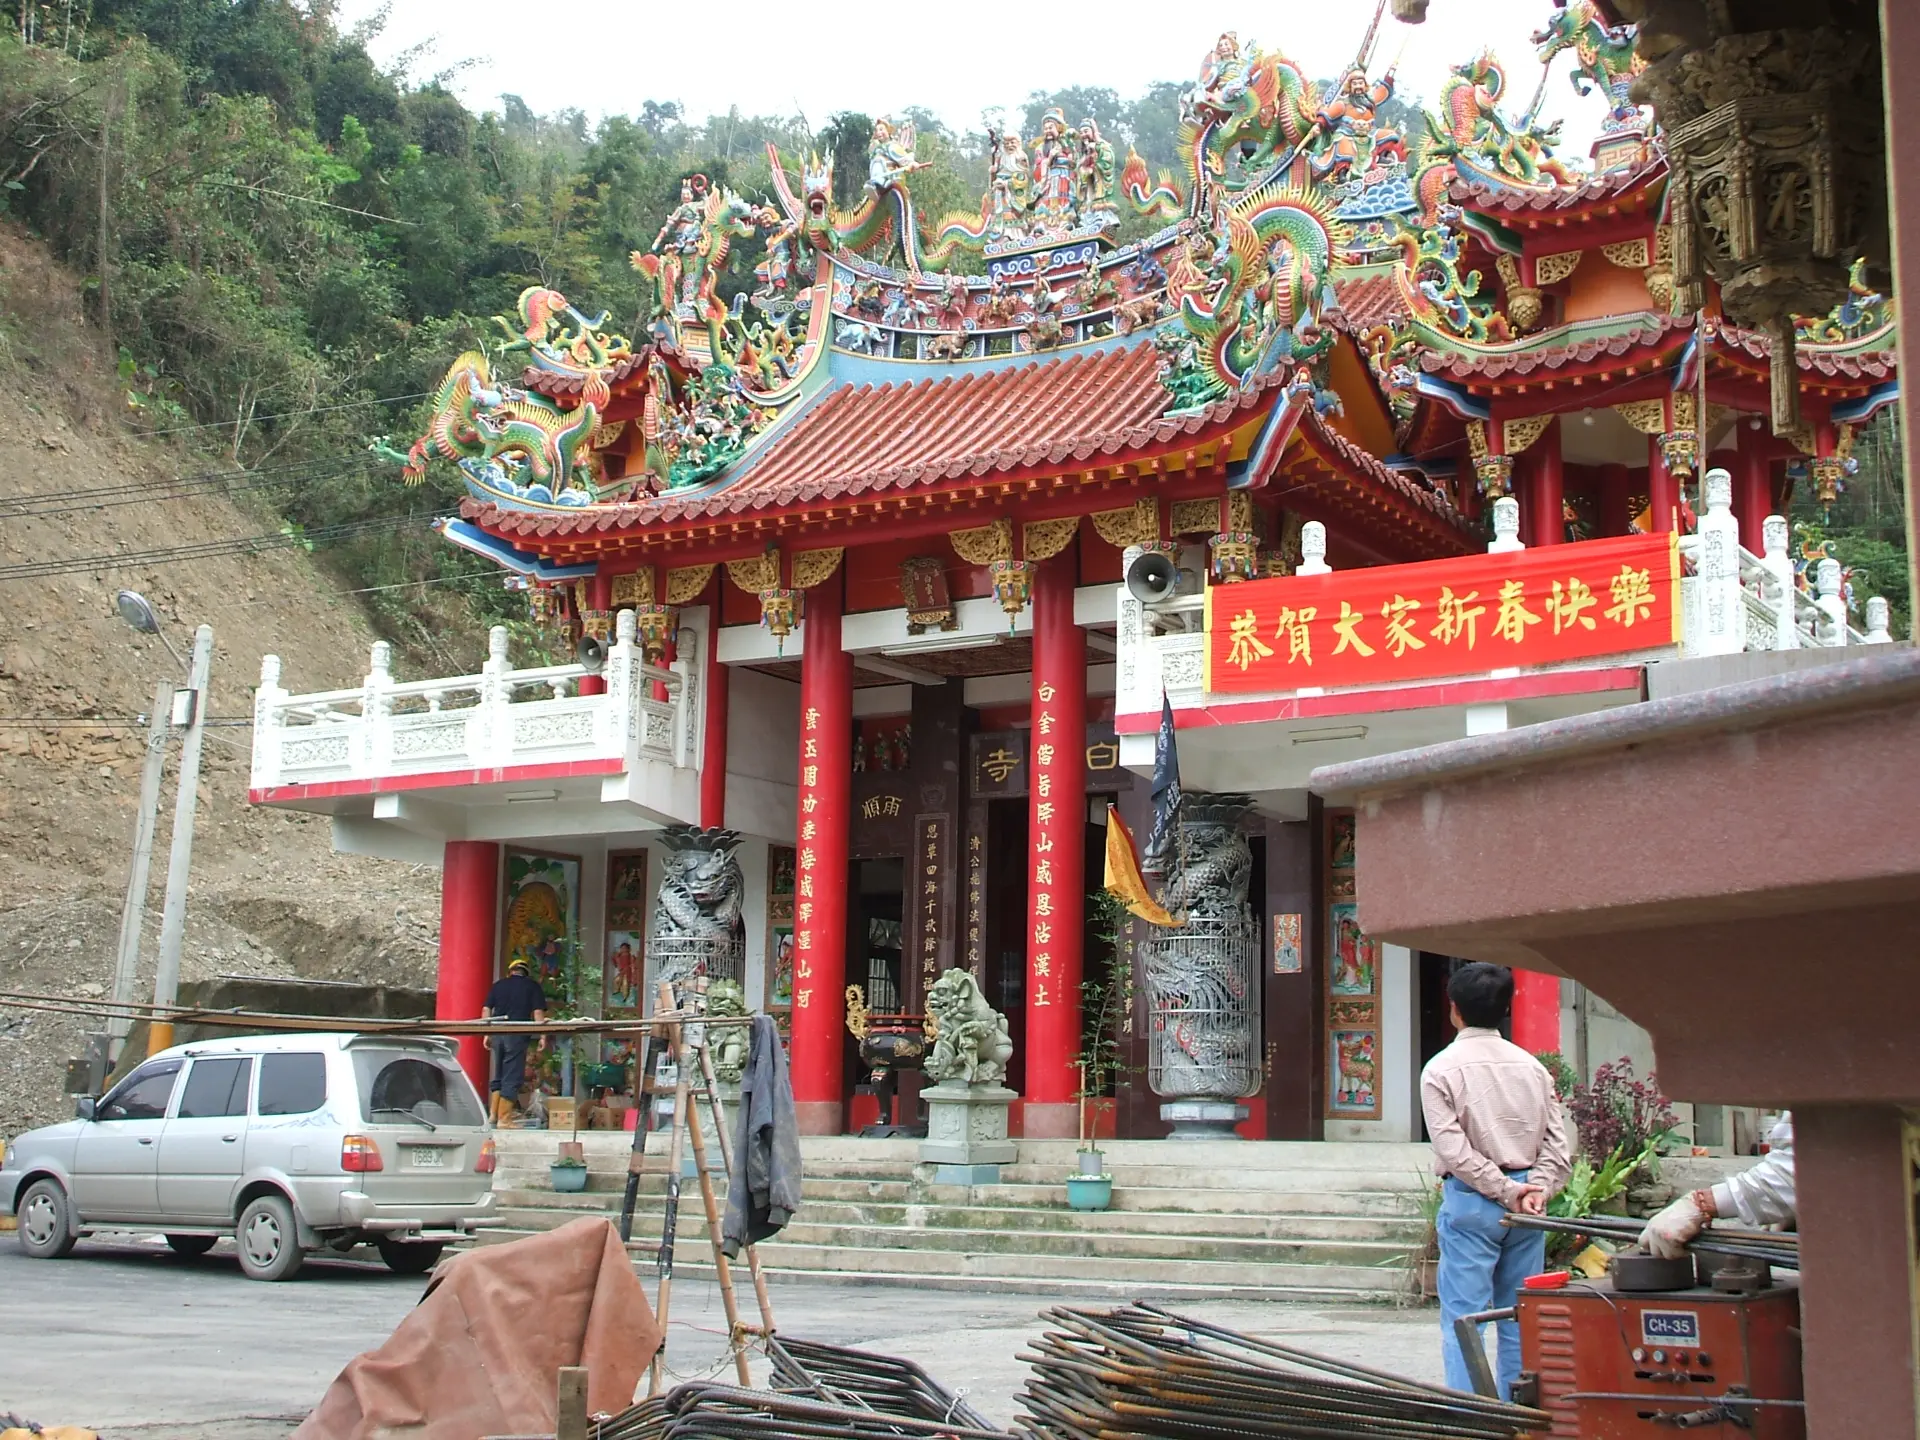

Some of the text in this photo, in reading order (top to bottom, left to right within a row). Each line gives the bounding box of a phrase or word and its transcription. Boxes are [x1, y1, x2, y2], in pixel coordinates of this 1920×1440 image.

[1225, 565, 1657, 671] 恭賀大家新春快樂
[1648, 1318, 1690, 1333] CH-35
